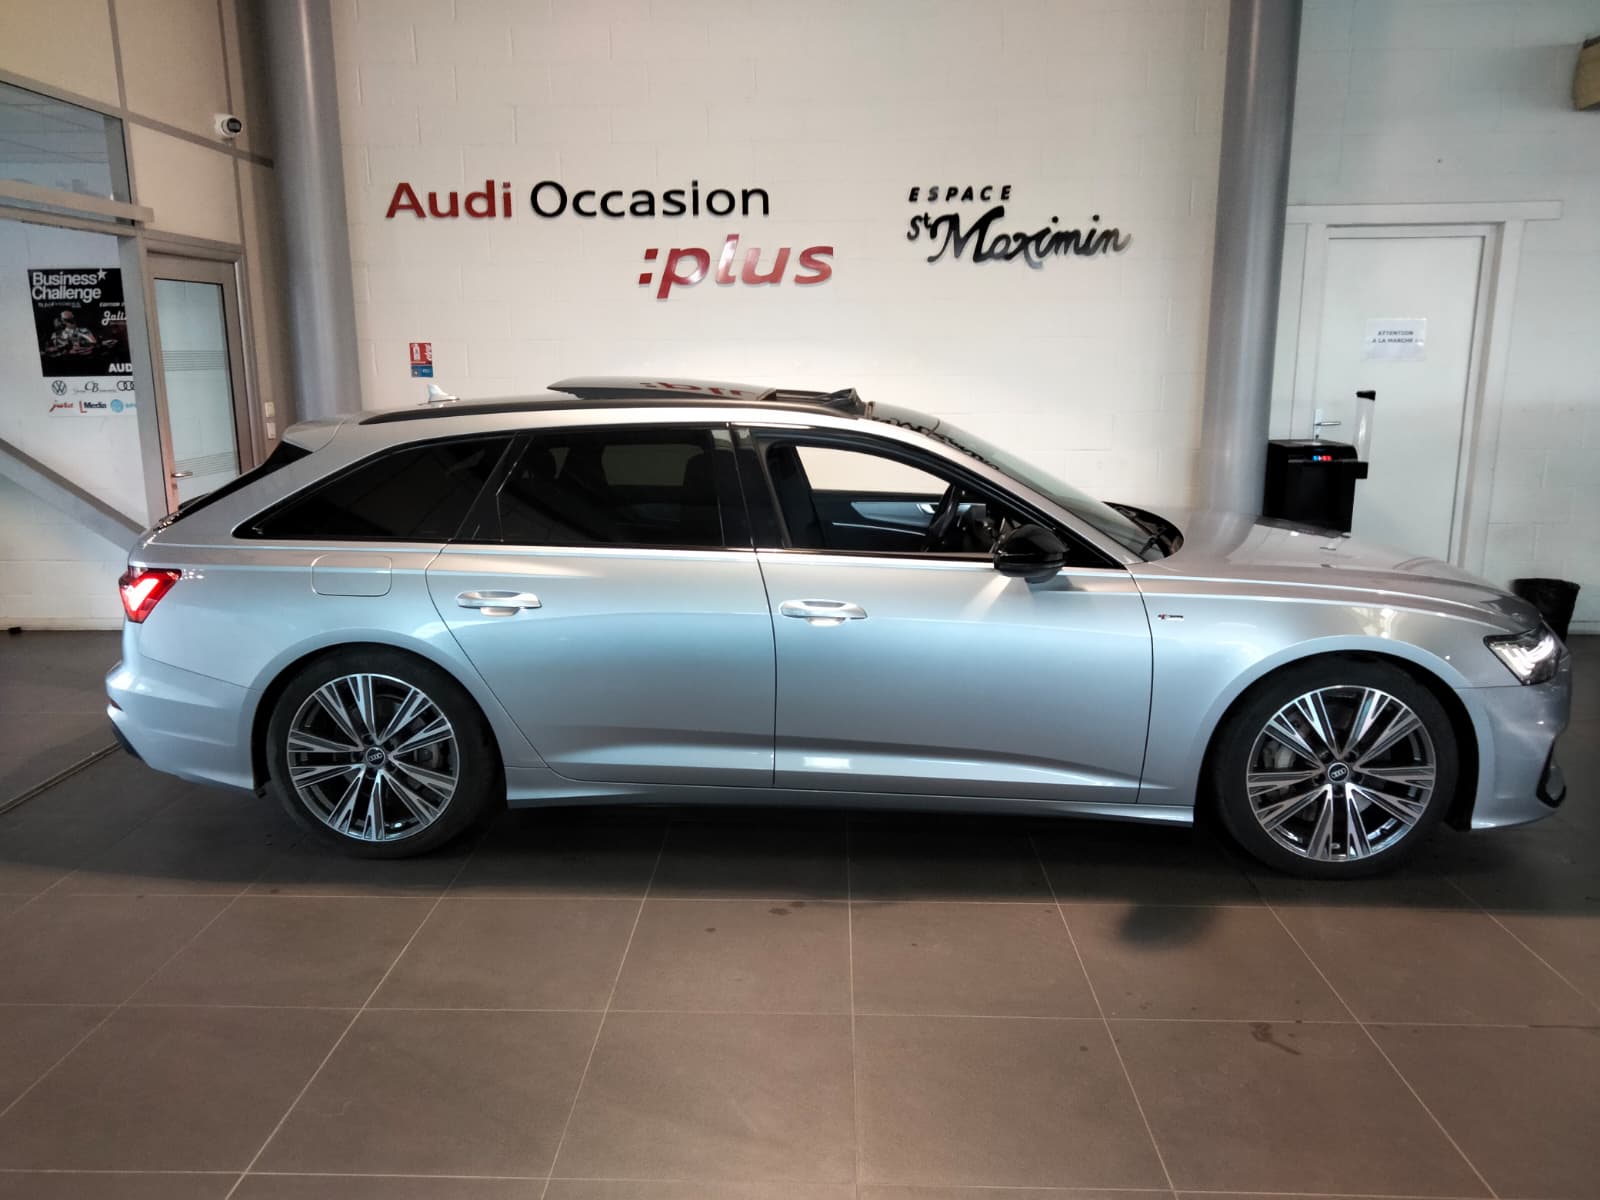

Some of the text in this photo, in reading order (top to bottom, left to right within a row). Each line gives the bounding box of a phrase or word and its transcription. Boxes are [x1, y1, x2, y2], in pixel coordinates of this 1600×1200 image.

[386, 179, 769, 218] Audi Occasion
[908, 185, 1012, 202] ESPACE
[906, 205, 1132, 269] St Maximin
[32, 271, 98, 286] Business
[32, 285, 102, 303] Challenge
